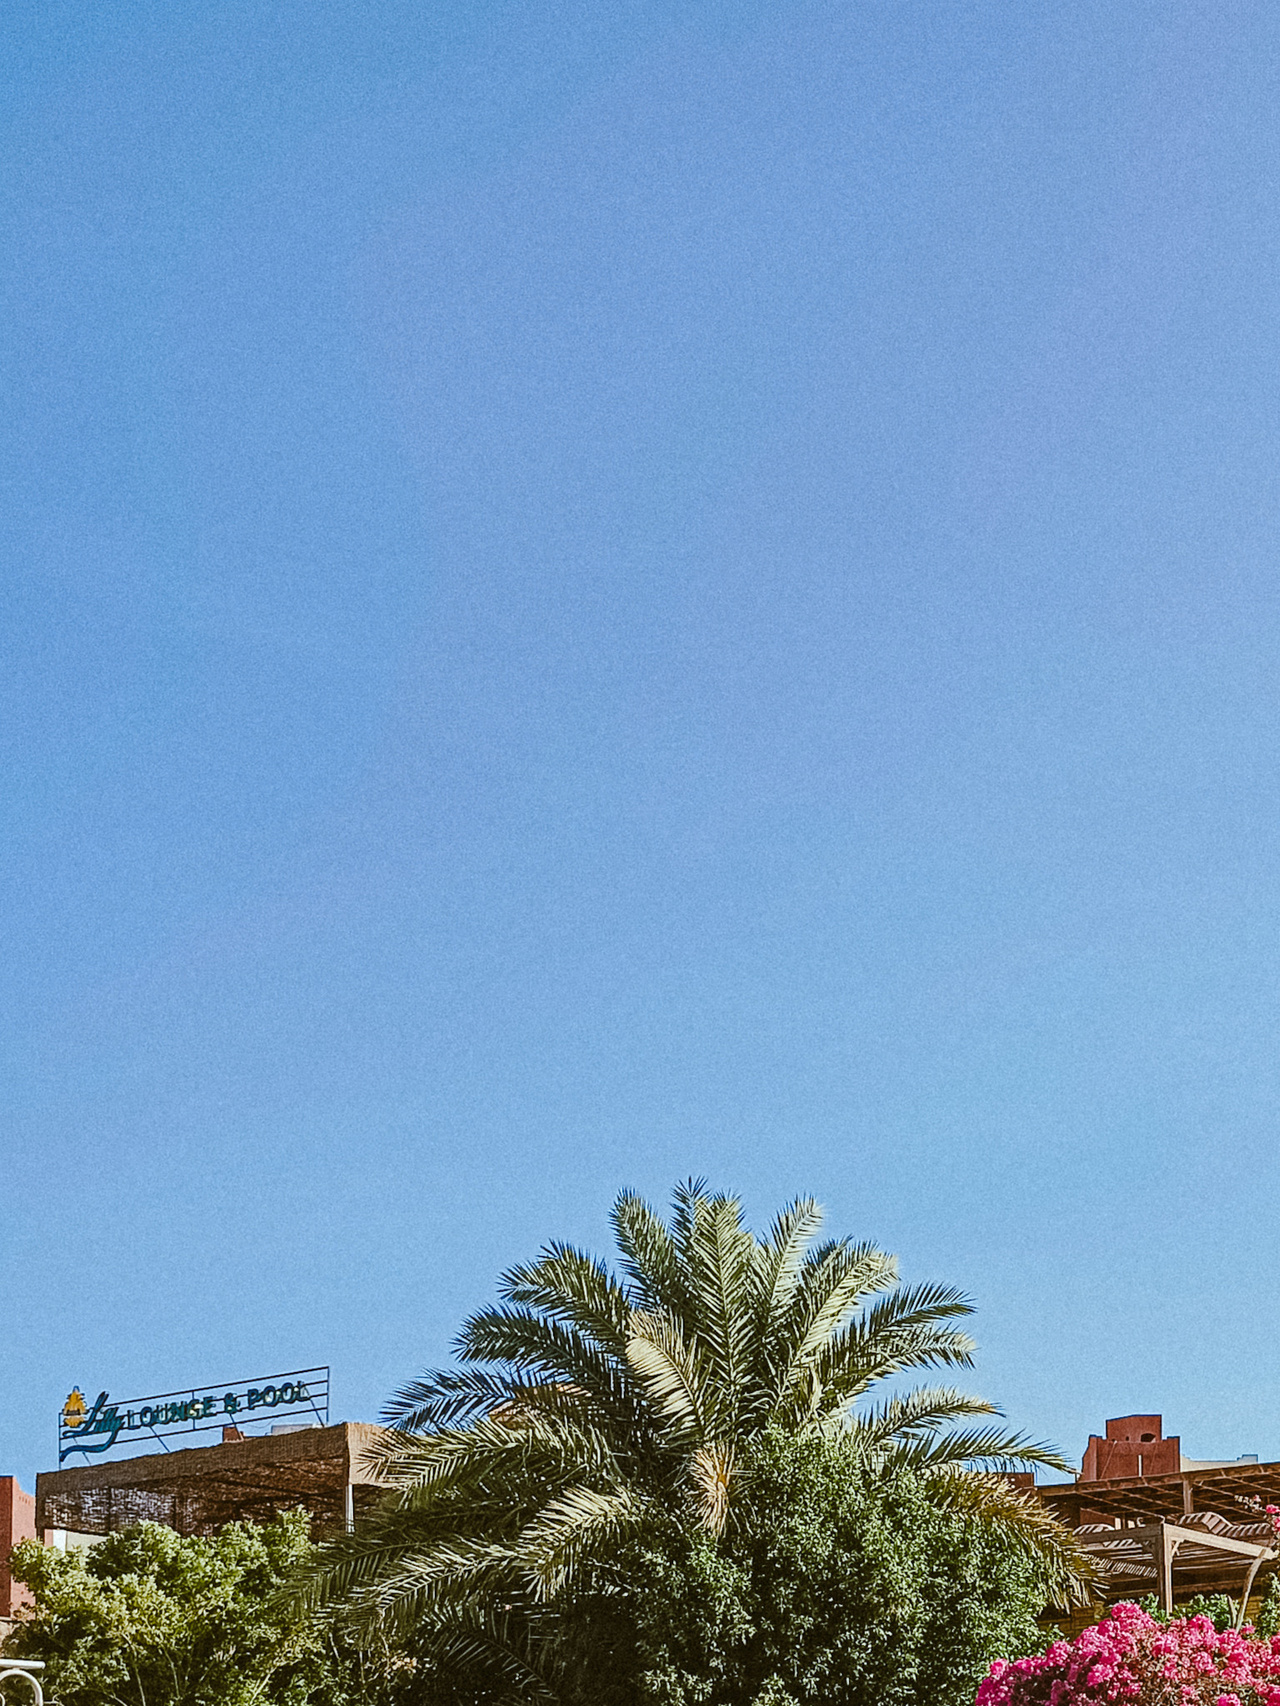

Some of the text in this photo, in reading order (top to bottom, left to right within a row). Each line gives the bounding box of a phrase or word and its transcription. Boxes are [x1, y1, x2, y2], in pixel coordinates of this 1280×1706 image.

[127, 1396, 216, 1429] LOUNGE
[224, 1393, 240, 1413] &
[247, 1381, 309, 1409] POOL
